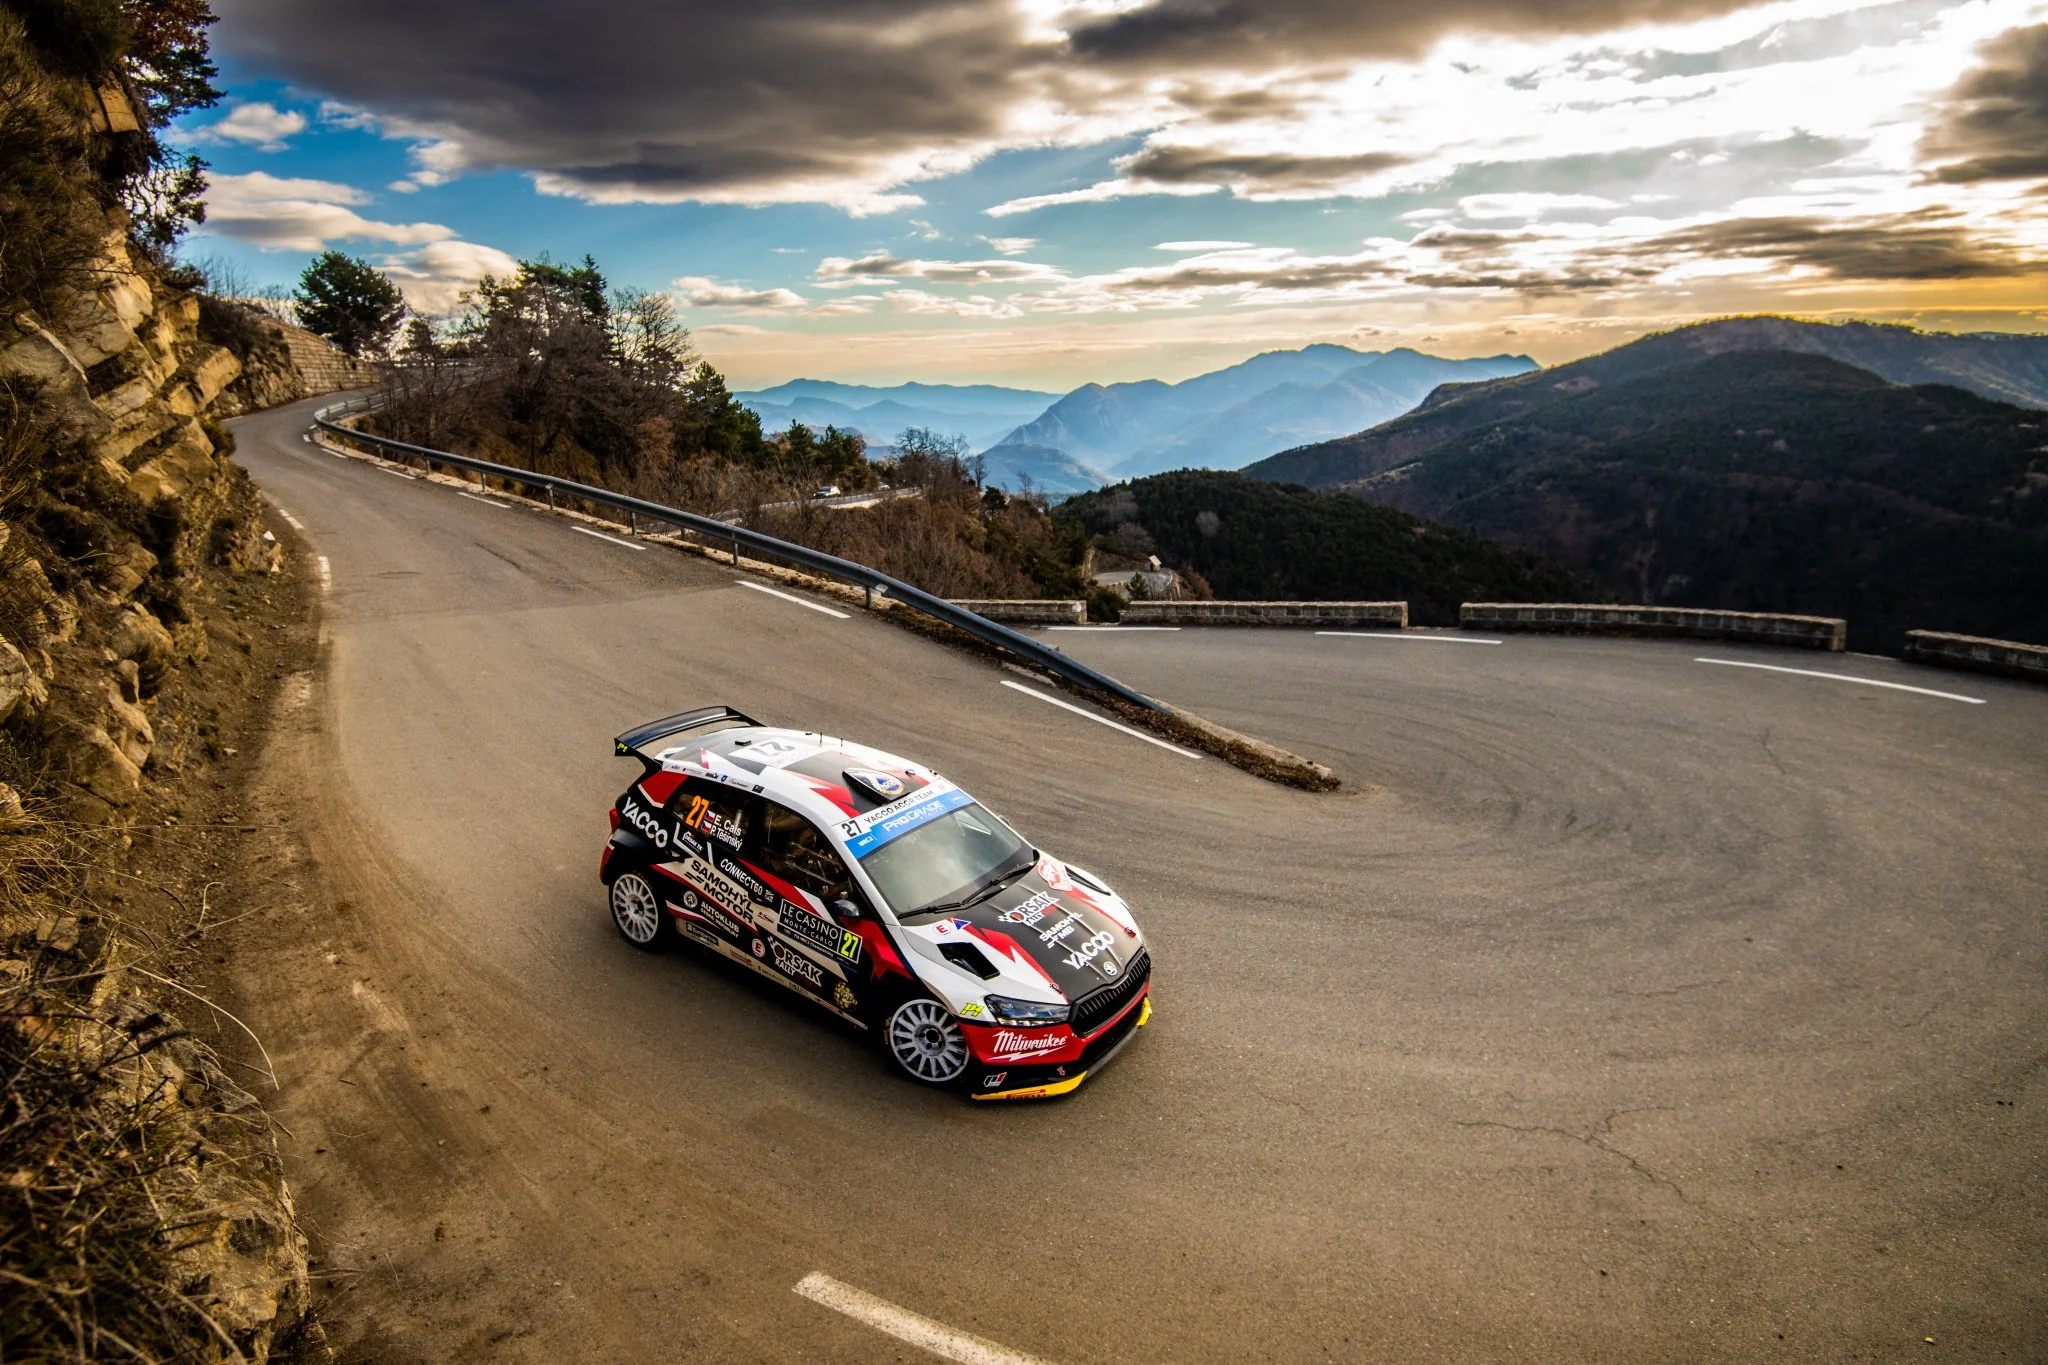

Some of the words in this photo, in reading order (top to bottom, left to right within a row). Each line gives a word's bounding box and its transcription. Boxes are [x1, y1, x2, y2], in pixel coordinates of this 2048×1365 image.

[622, 796, 668, 848] YACCO
[685, 795, 709, 829] 27
[714, 814, 722, 827] E.
[841, 819, 862, 837] 27
[864, 807, 894, 825] YACCO
[914, 790, 934, 802] TEAM
[700, 901, 740, 933] AUTOKLUB
[703, 882, 754, 924] MOTOR
[783, 903, 795, 918] LE
[795, 911, 839, 940] CASINO
[1024, 912, 1044, 927] RALLY
[1058, 926, 1075, 940] MB
[841, 932, 859, 959] 27
[1062, 930, 1115, 970] YACCO
[775, 958, 796, 976] RALLY
[960, 1003, 984, 1017] P1
[992, 1030, 1067, 1054] Milwaukee
